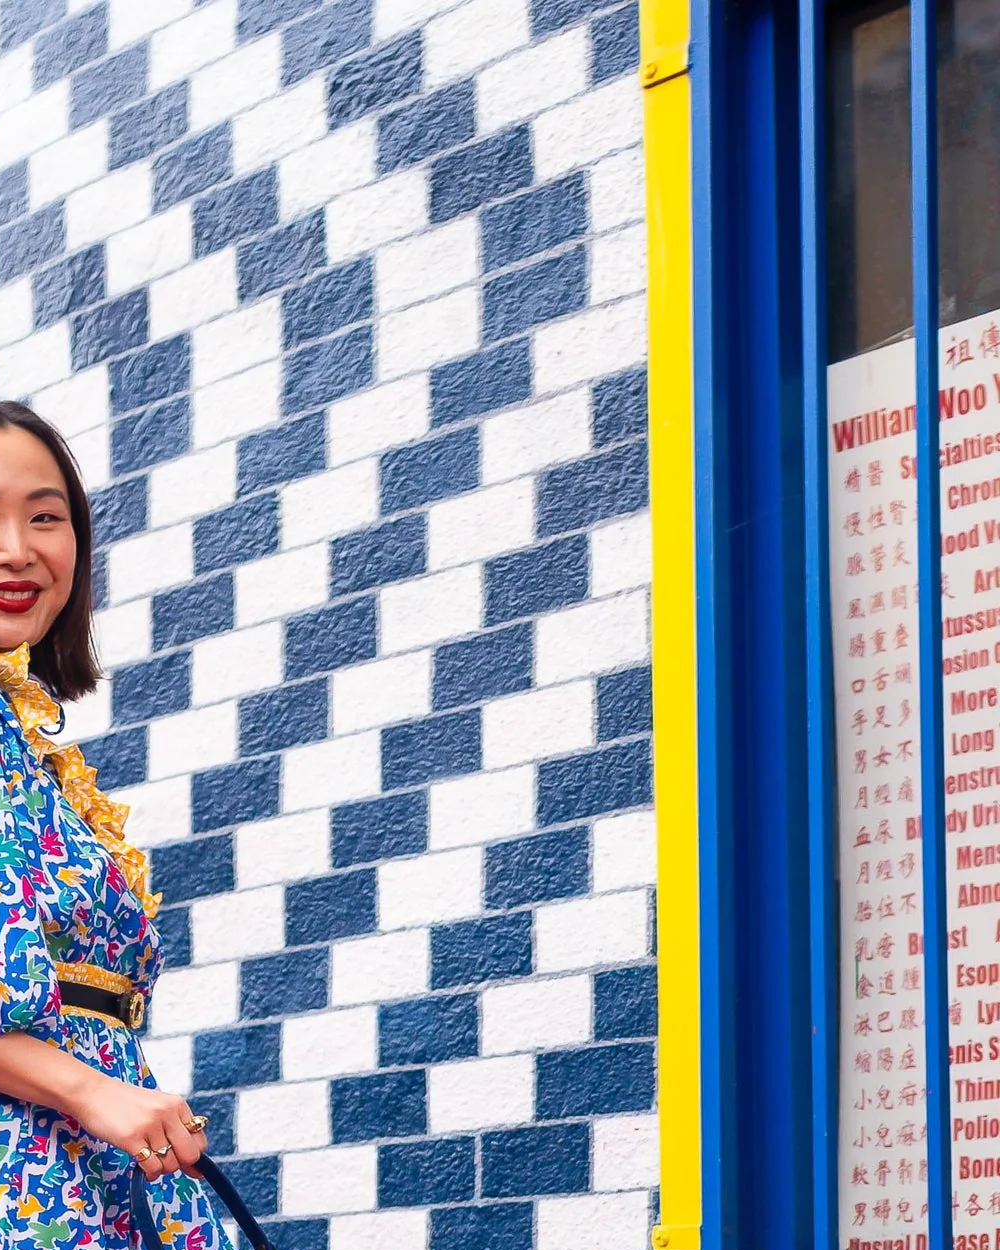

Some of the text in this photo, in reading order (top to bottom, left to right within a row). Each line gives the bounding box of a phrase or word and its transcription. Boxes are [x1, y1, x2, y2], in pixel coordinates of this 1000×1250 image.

[941, 524, 979, 556] lood
[950, 687, 997, 716] More
[952, 729, 994, 756] Long
[956, 963, 999, 988] Esop
[953, 1114, 1000, 1142] Polio
